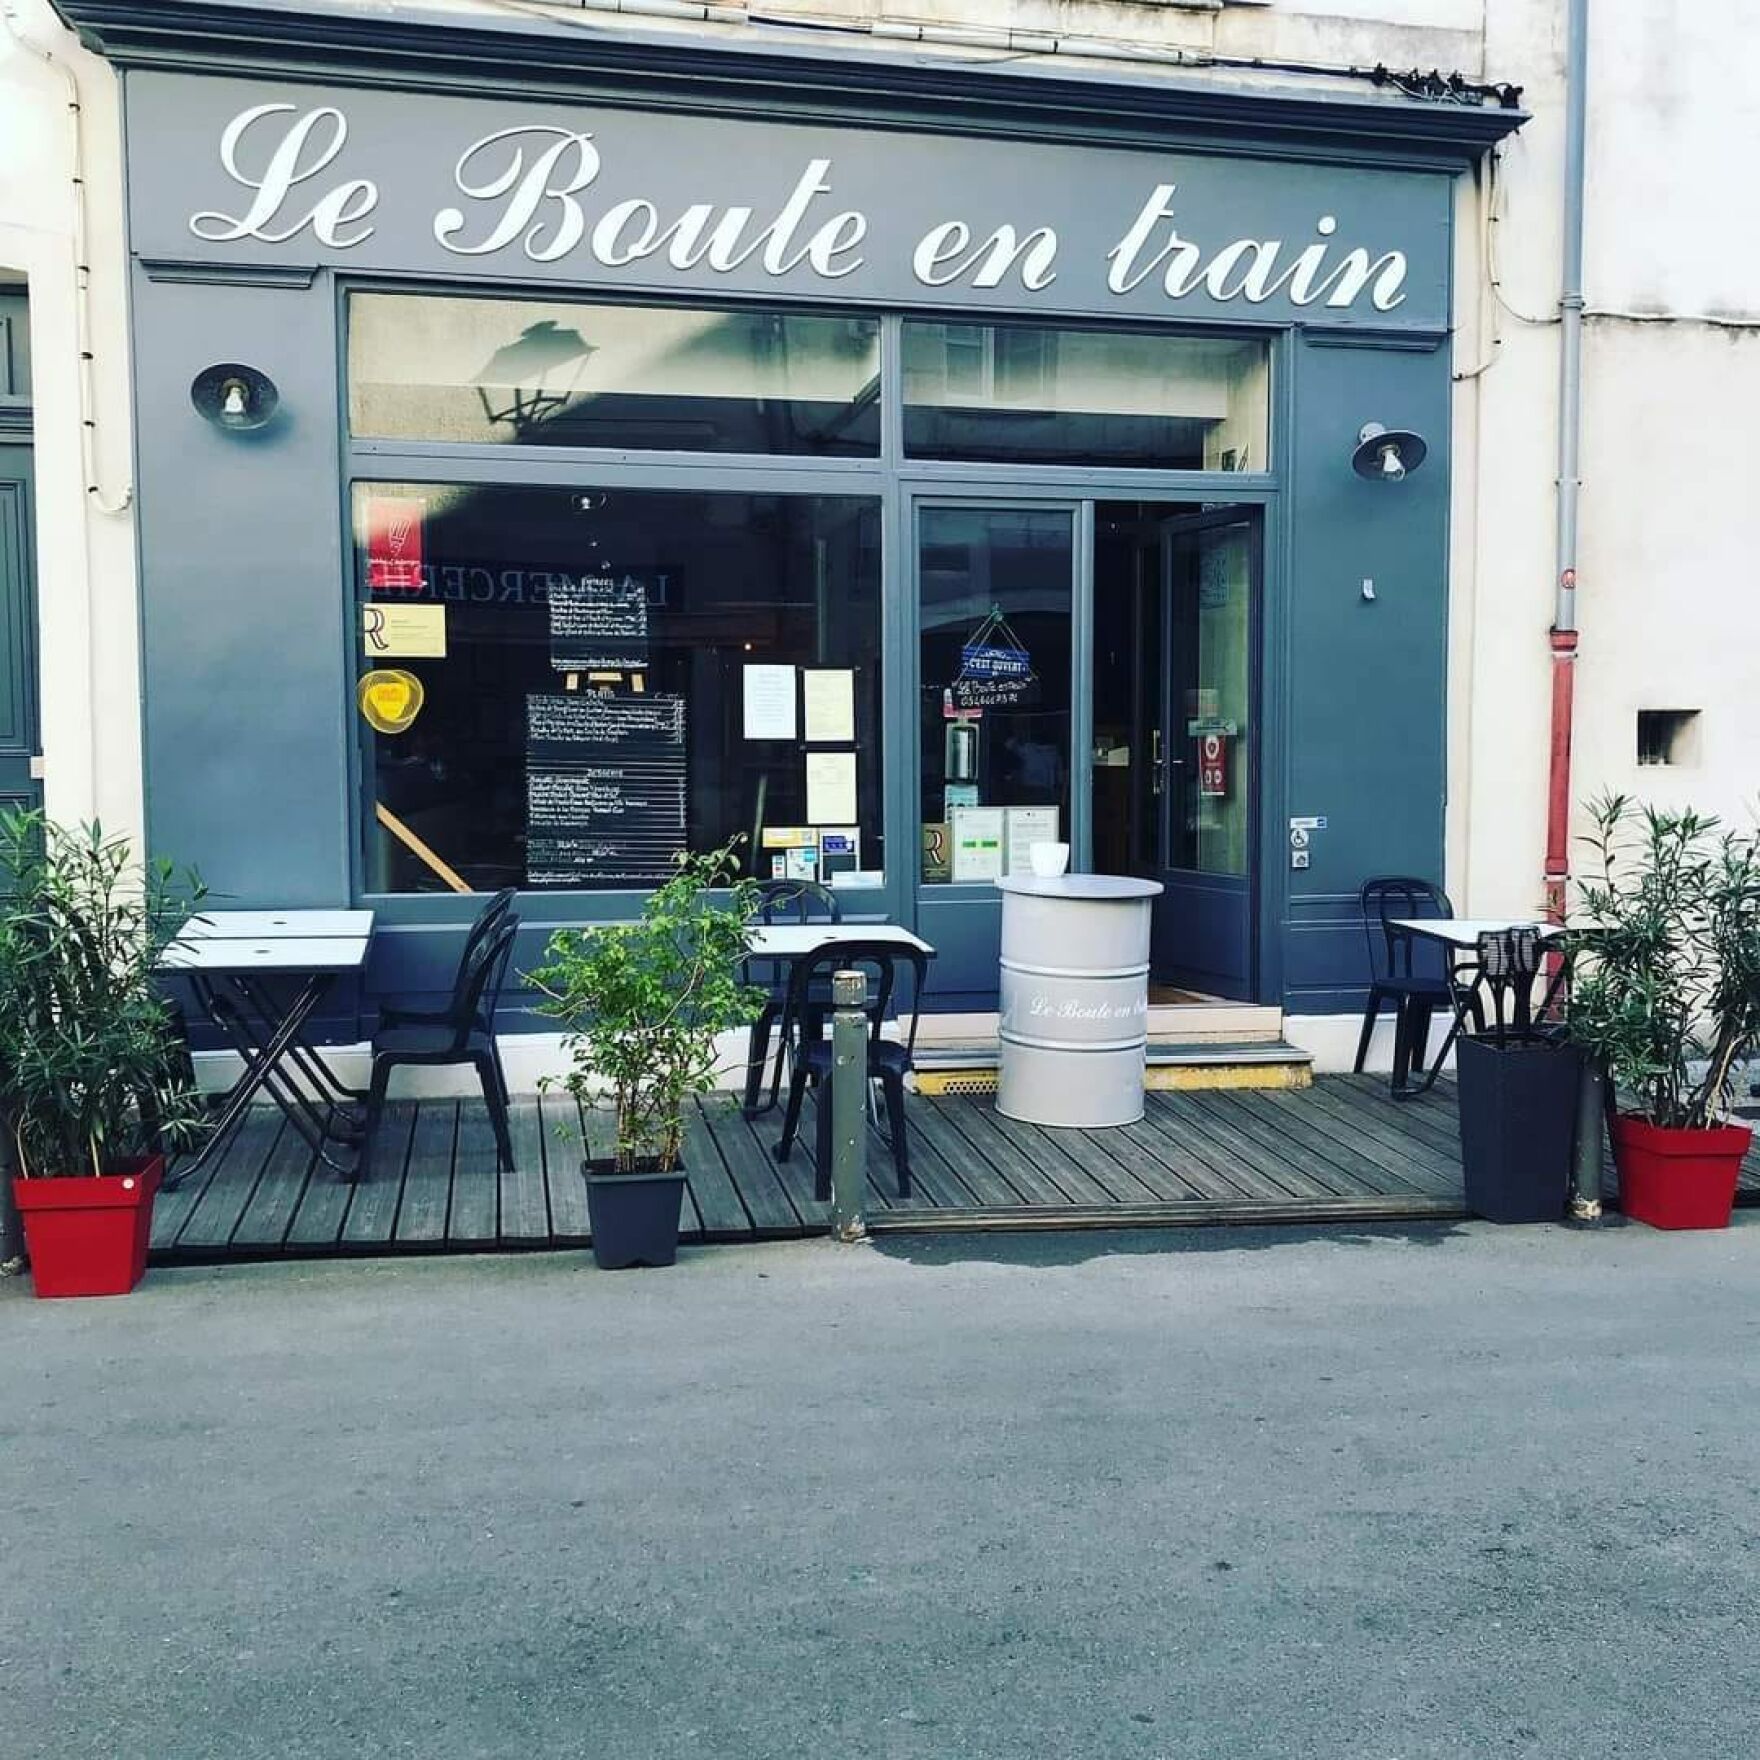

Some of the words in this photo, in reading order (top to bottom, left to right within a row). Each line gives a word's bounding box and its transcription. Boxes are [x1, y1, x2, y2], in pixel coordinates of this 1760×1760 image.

[188, 103, 379, 248] Le
[433, 125, 868, 278] Boute
[912, 220, 1058, 291] en
[1106, 184, 1408, 311] train
[1029, 992, 1051, 1017] Le
[1057, 998, 1111, 1019] Boute
